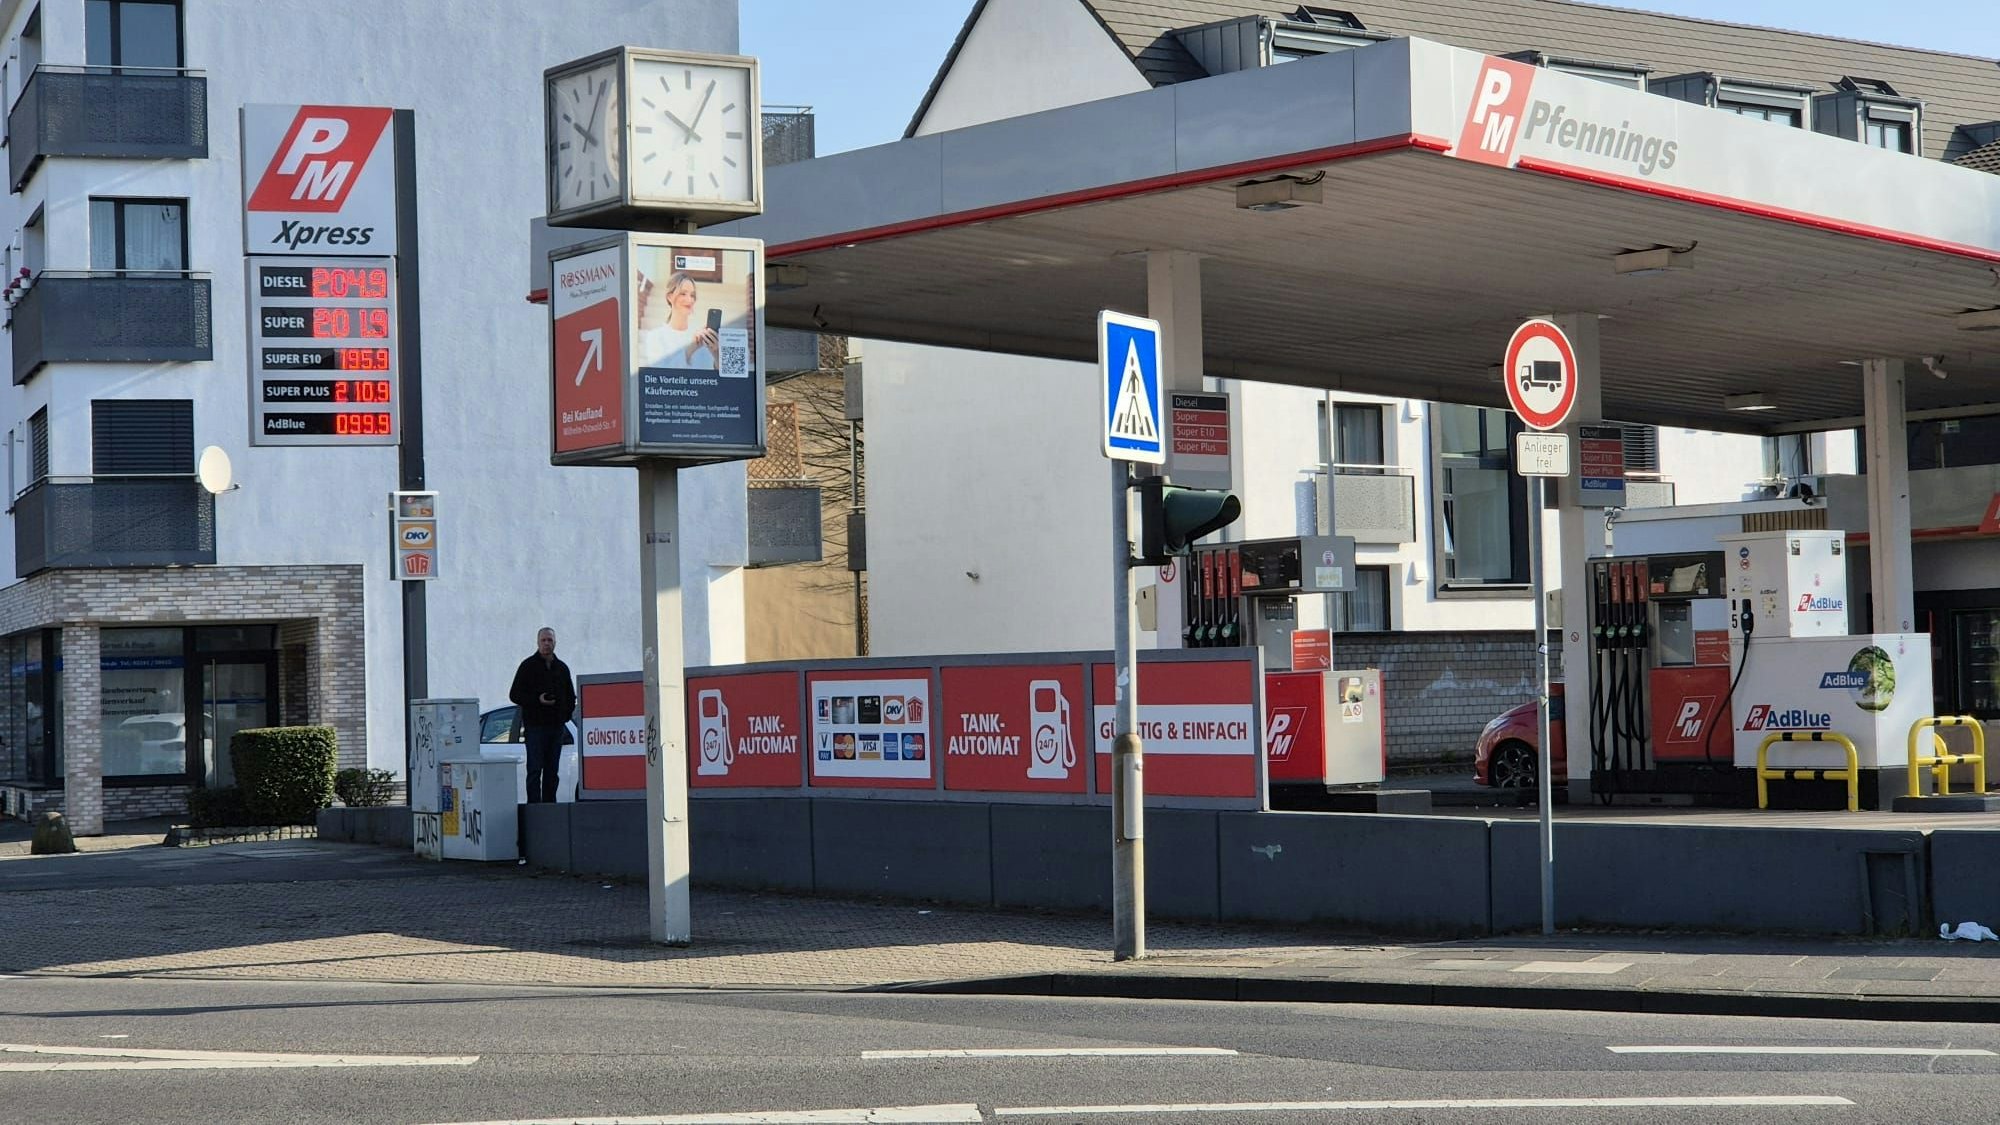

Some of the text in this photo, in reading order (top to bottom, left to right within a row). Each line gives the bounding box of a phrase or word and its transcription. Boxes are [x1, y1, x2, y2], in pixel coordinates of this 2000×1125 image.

[1523, 99, 1679, 175] Pfennings
[271, 220, 374, 250] Xpress
[263, 276, 307, 288] DIESEL
[560, 263, 616, 289] ROSSMANN
[264, 316, 305, 328] SUPER
[265, 353, 301, 364] SUPER
[303, 353, 322, 364] E10
[644, 375, 718, 386] Die Vorteile unseres
[266, 386, 301, 397] SUPER
[303, 386, 330, 397] PLUS
[644, 386, 699, 397] Käuferservices
[1175, 397, 1198, 407] Diesel
[562, 411, 574, 423] Bei
[1175, 411, 1198, 423] Super
[267, 418, 306, 429] AdBlue
[1176, 426, 1215, 438] Super E10
[1176, 441, 1216, 453] Super Plus
[1524, 440, 1563, 456] Anlieger
[1536, 457, 1552, 468] frei
[405, 531, 429, 540] DKV
[406, 553, 430, 574] UTA
[1809, 597, 1843, 609] AdBlue
[1731, 614, 1738, 629] 5
[1824, 674, 1865, 686] AdBlue
[886, 705, 903, 715] DKV
[960, 713, 1005, 733] TANK-
[1766, 709, 1832, 727] AdBlue
[748, 715, 785, 734] TANK-
[1100, 718, 1248, 740] GÜTIG & EINFACH
[587, 727, 627, 746] GÜNSTIG
[629, 730, 638, 744] &
[738, 735, 798, 755] AUTOMAT
[862, 741, 877, 751] VISA
[948, 735, 1020, 756] AUTOMAT
[1038, 738, 1054, 750] 24/7
